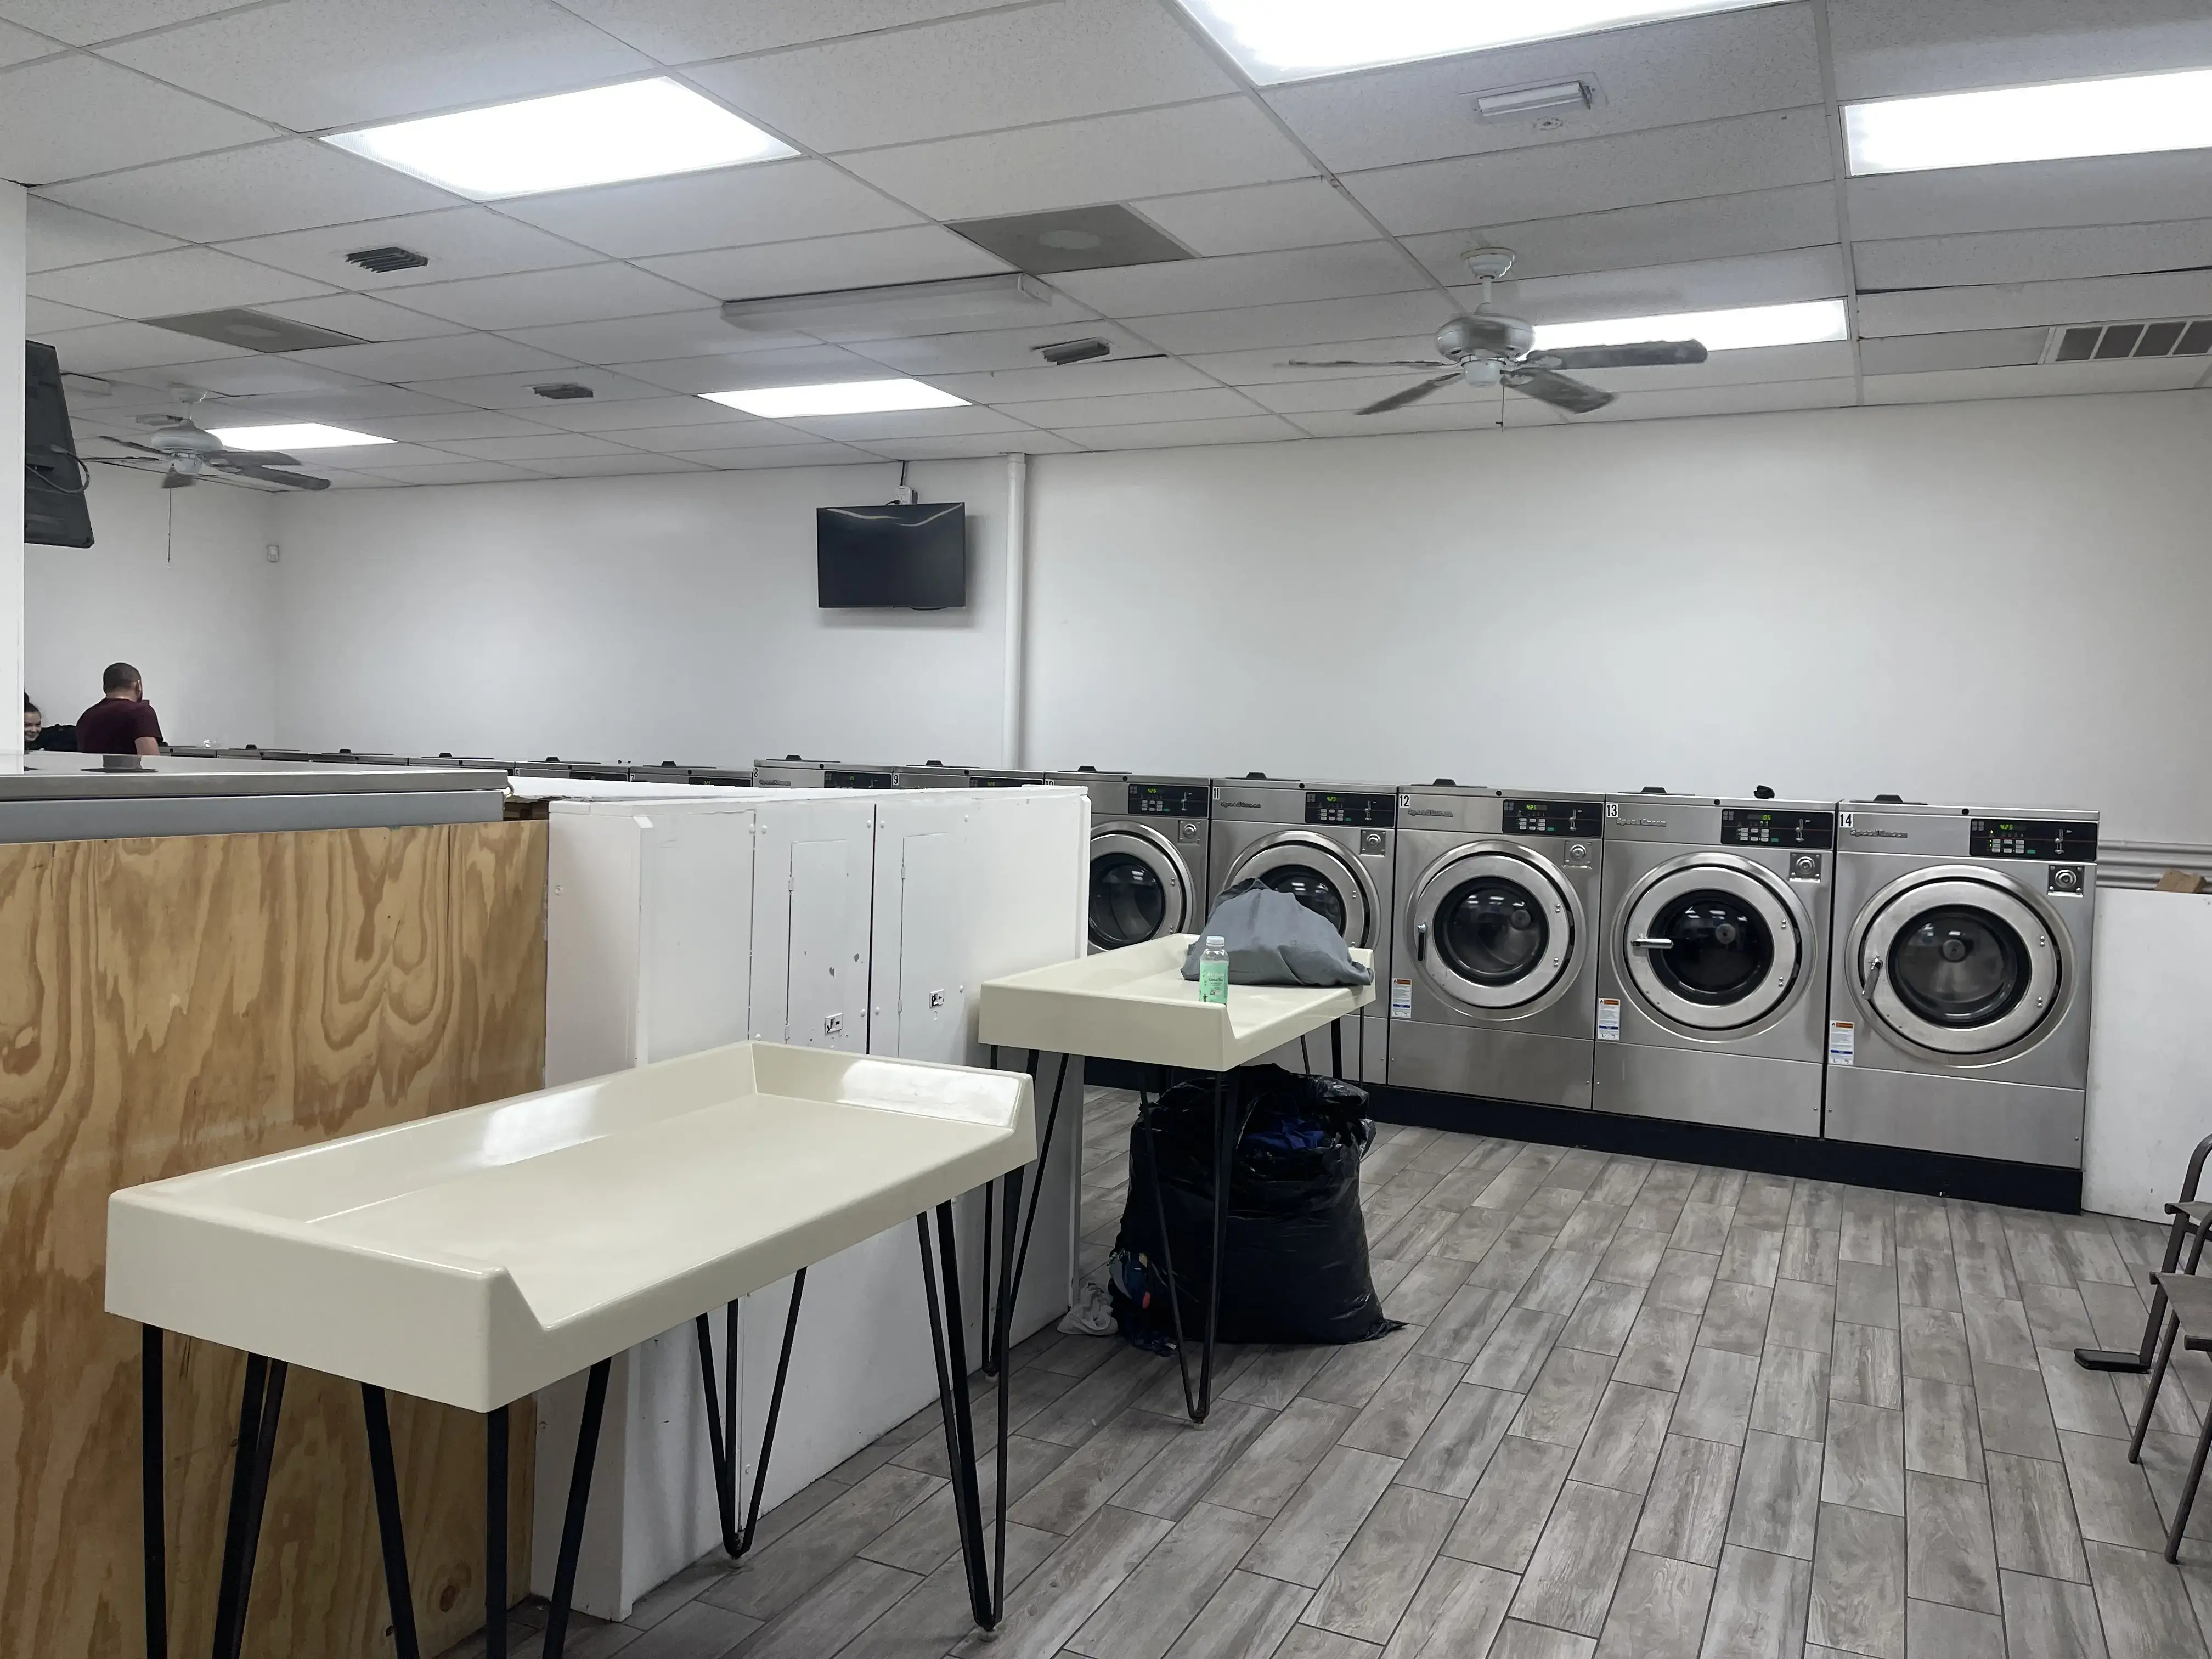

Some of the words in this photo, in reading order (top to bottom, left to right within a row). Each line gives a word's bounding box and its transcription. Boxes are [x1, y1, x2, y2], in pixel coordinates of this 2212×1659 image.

[754, 768, 758, 778] 8
[894, 774, 898, 785] 9
[1213, 787, 1220, 799] 11
[1400, 795, 1409, 807] 12
[1607, 804, 1617, 817] 13
[1840, 813, 1852, 827] 14
